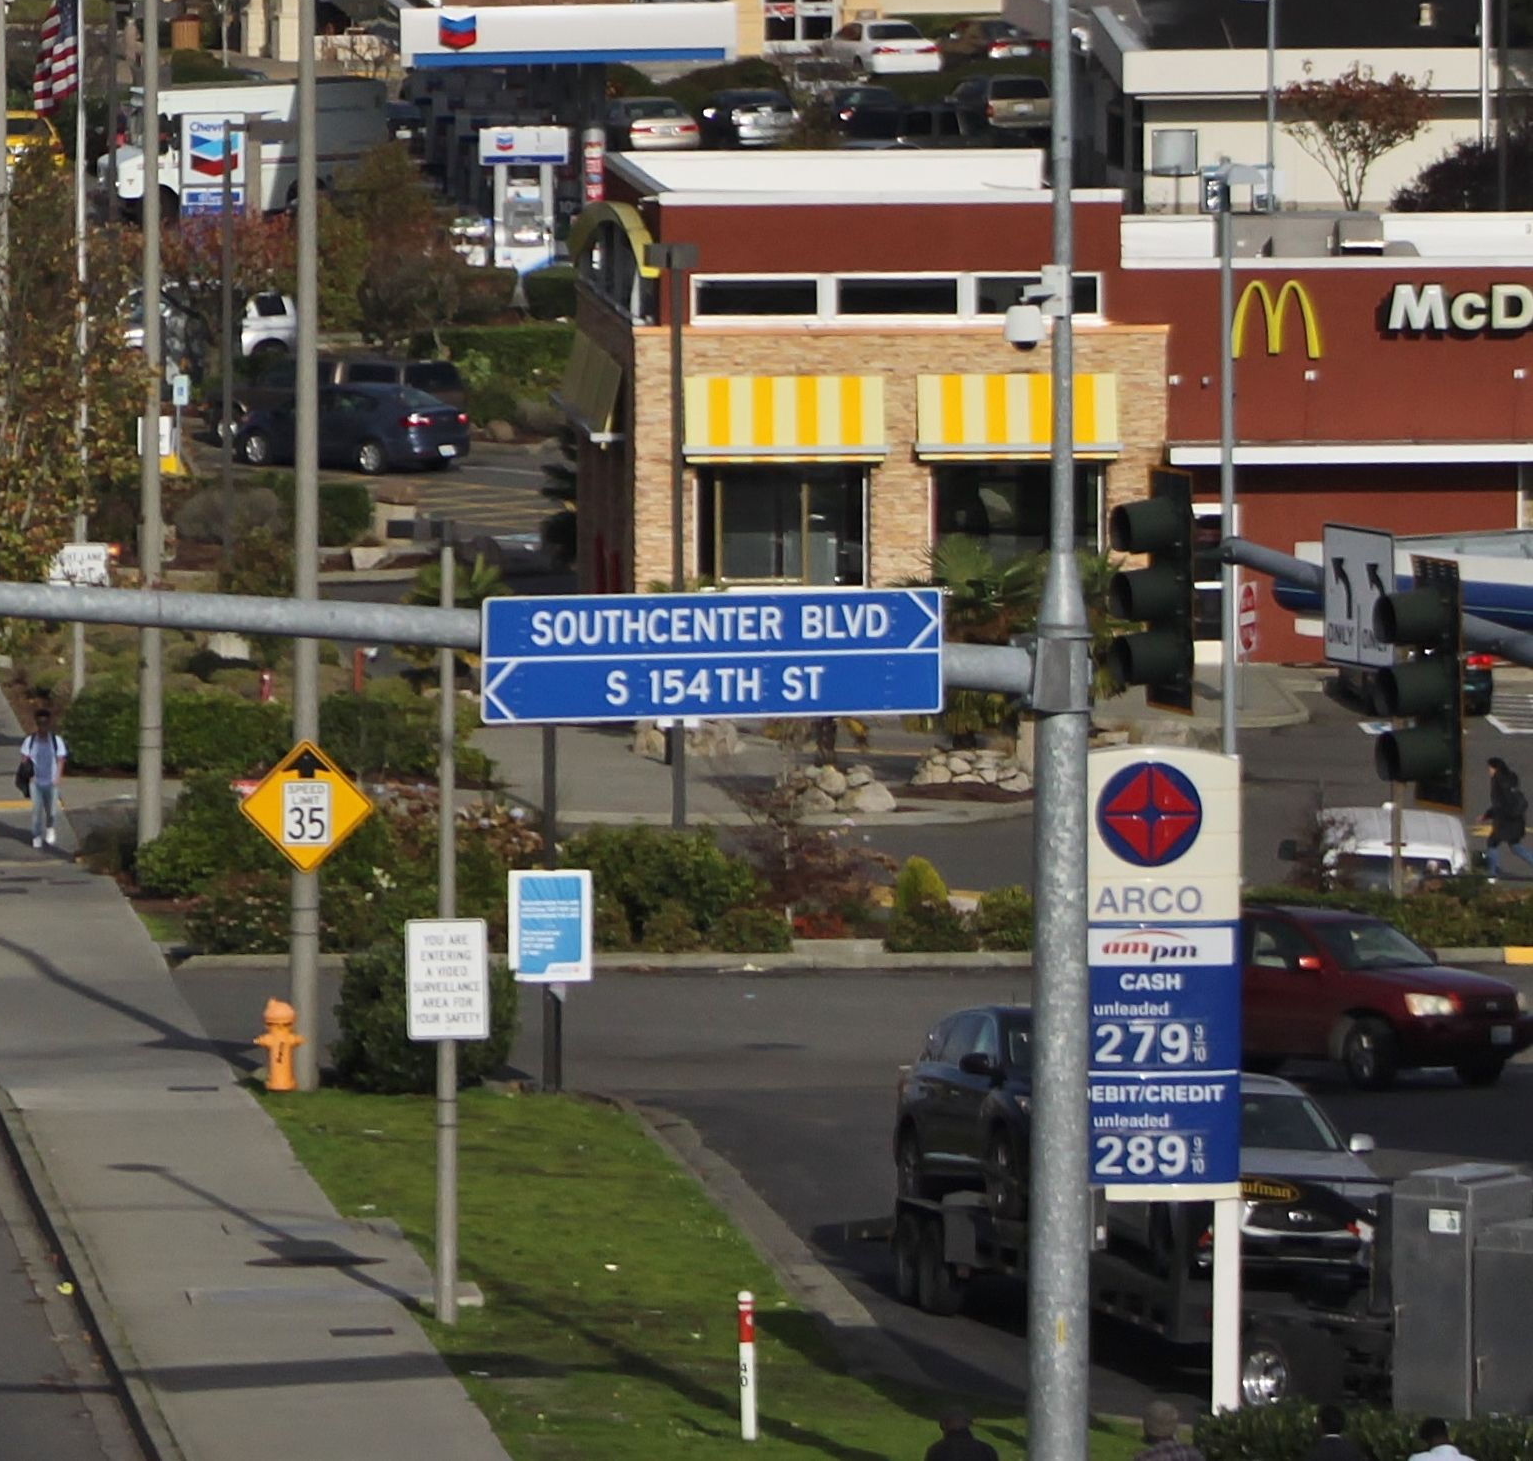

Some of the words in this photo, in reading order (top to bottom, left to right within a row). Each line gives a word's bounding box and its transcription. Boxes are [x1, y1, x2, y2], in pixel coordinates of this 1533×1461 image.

[189, 121, 224, 132] Chevr
[1387, 283, 1533, 331] McD
[530, 606, 783, 647] SOUTHCENTER
[801, 603, 889, 639] BLVD
[1327, 622, 1355, 646] ONLY
[606, 669, 630, 706] S
[648, 667, 762, 705] 154TH
[781, 666, 824, 702] ST
[288, 784, 326, 795] SPEED
[288, 806, 326, 840] 35
[1095, 885, 1203, 914] ARCO
[423, 934, 444, 946] YOU
[449, 934, 469, 945] ARE
[420, 950, 472, 961] ENTERING
[437, 965, 468, 977] VIDEO
[412, 981, 481, 993] SURVEILLANCE
[1119, 973, 1182, 991] CASH
[422, 998, 449, 1008] AREA
[1093, 1000, 1170, 1017] unleaded
[414, 1013, 440, 1024] YOUR
[445, 1012, 481, 1024] SAFETY
[1094, 1023, 1189, 1064] 279
[1087, 1084, 1225, 1103] EBIT/CREDIT
[1093, 1112, 1170, 1128] unleaded
[1094, 1135, 1188, 1176] 289
